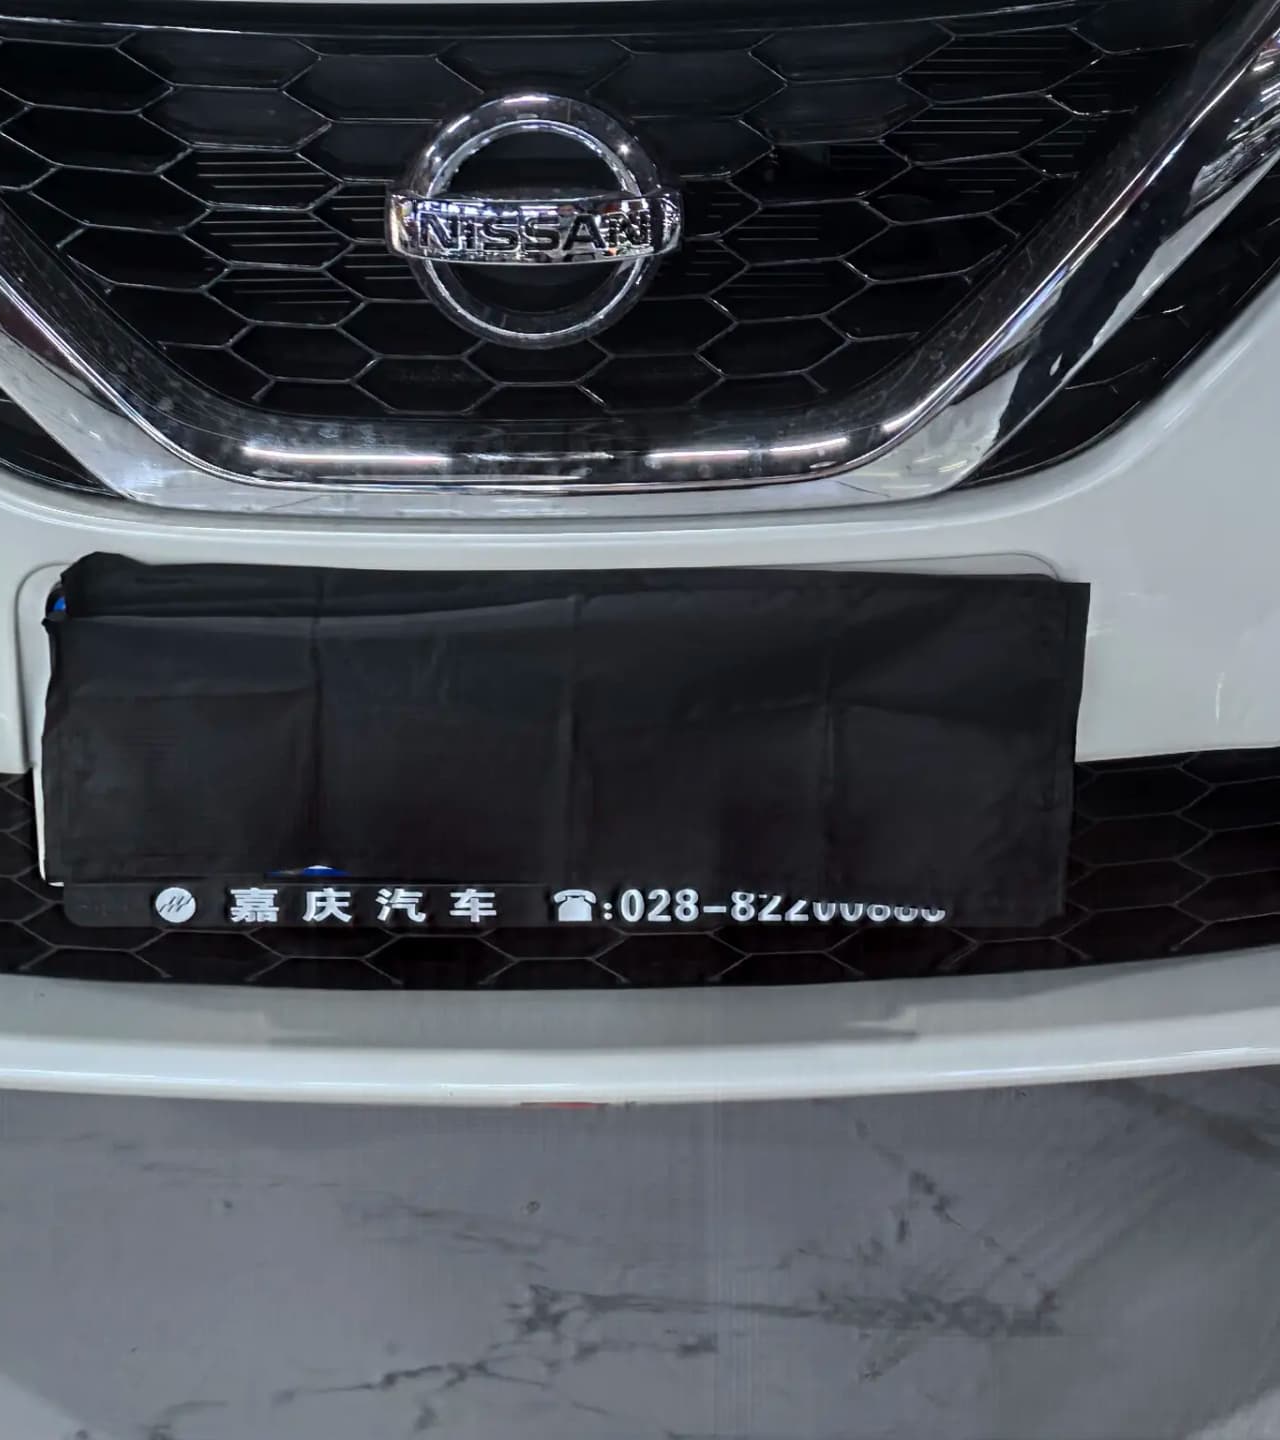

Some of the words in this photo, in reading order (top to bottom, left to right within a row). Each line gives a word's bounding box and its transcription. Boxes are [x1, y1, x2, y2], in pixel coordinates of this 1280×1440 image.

[417, 211, 652, 254] NISSAN
[230, 887, 498, 923] 嘉庆汽车
